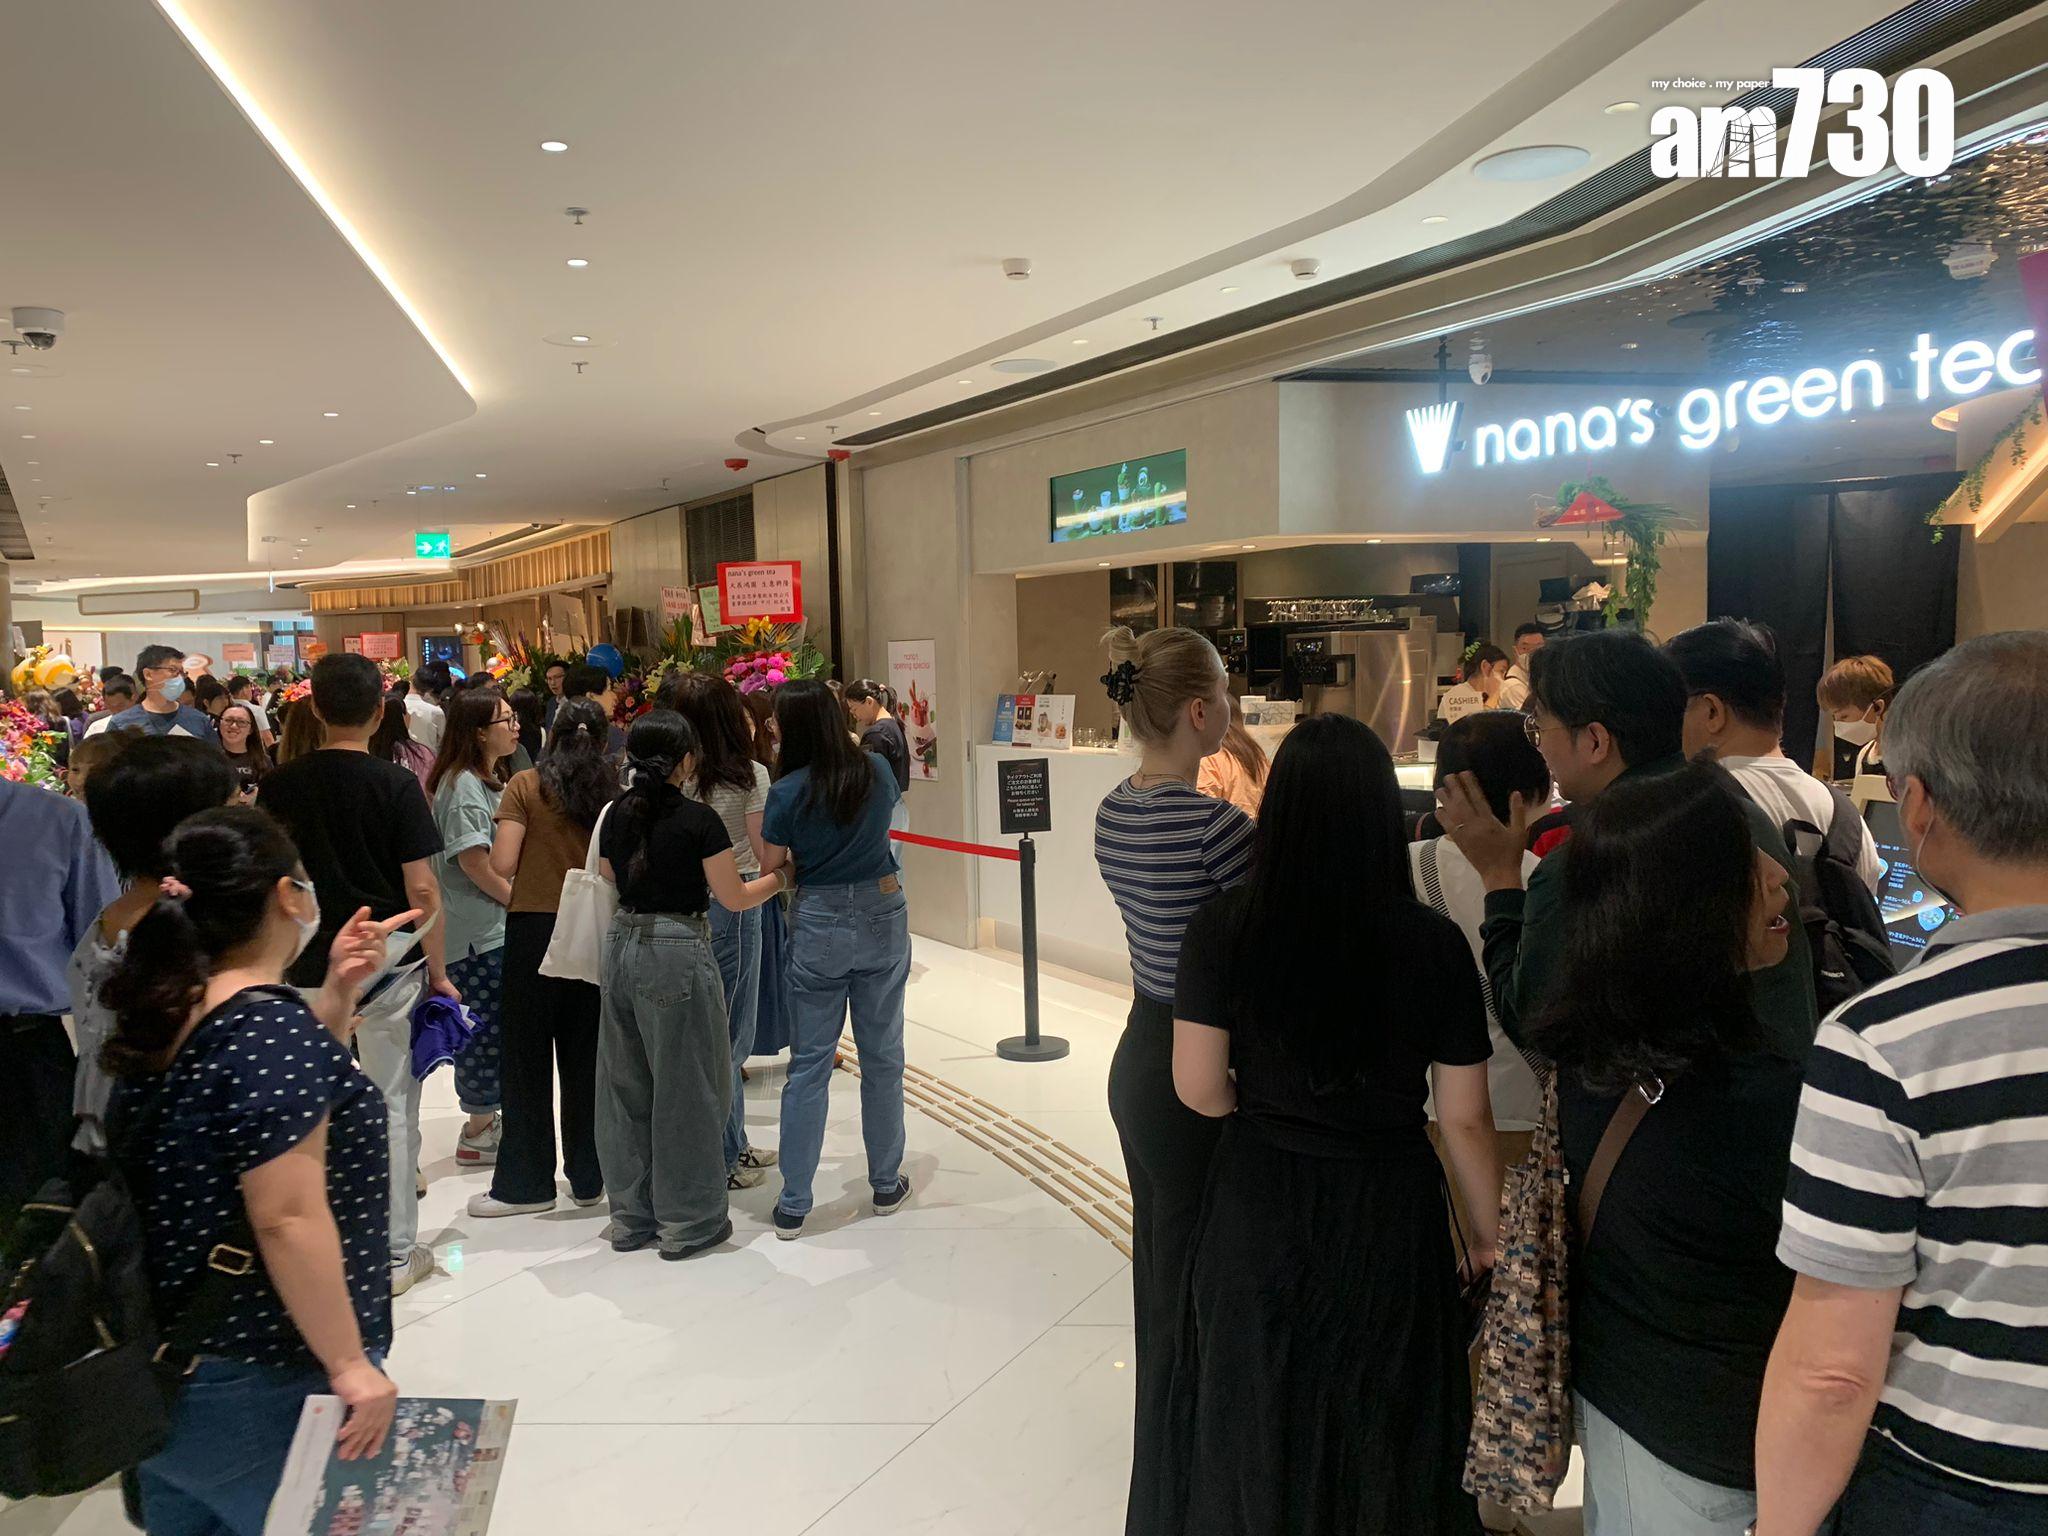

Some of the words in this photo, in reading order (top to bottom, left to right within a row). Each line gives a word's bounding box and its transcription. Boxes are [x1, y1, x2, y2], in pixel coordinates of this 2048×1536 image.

[1474, 398, 1655, 466] nana's
[1678, 358, 1886, 449] green
[1448, 697, 1479, 705] CASHIER
